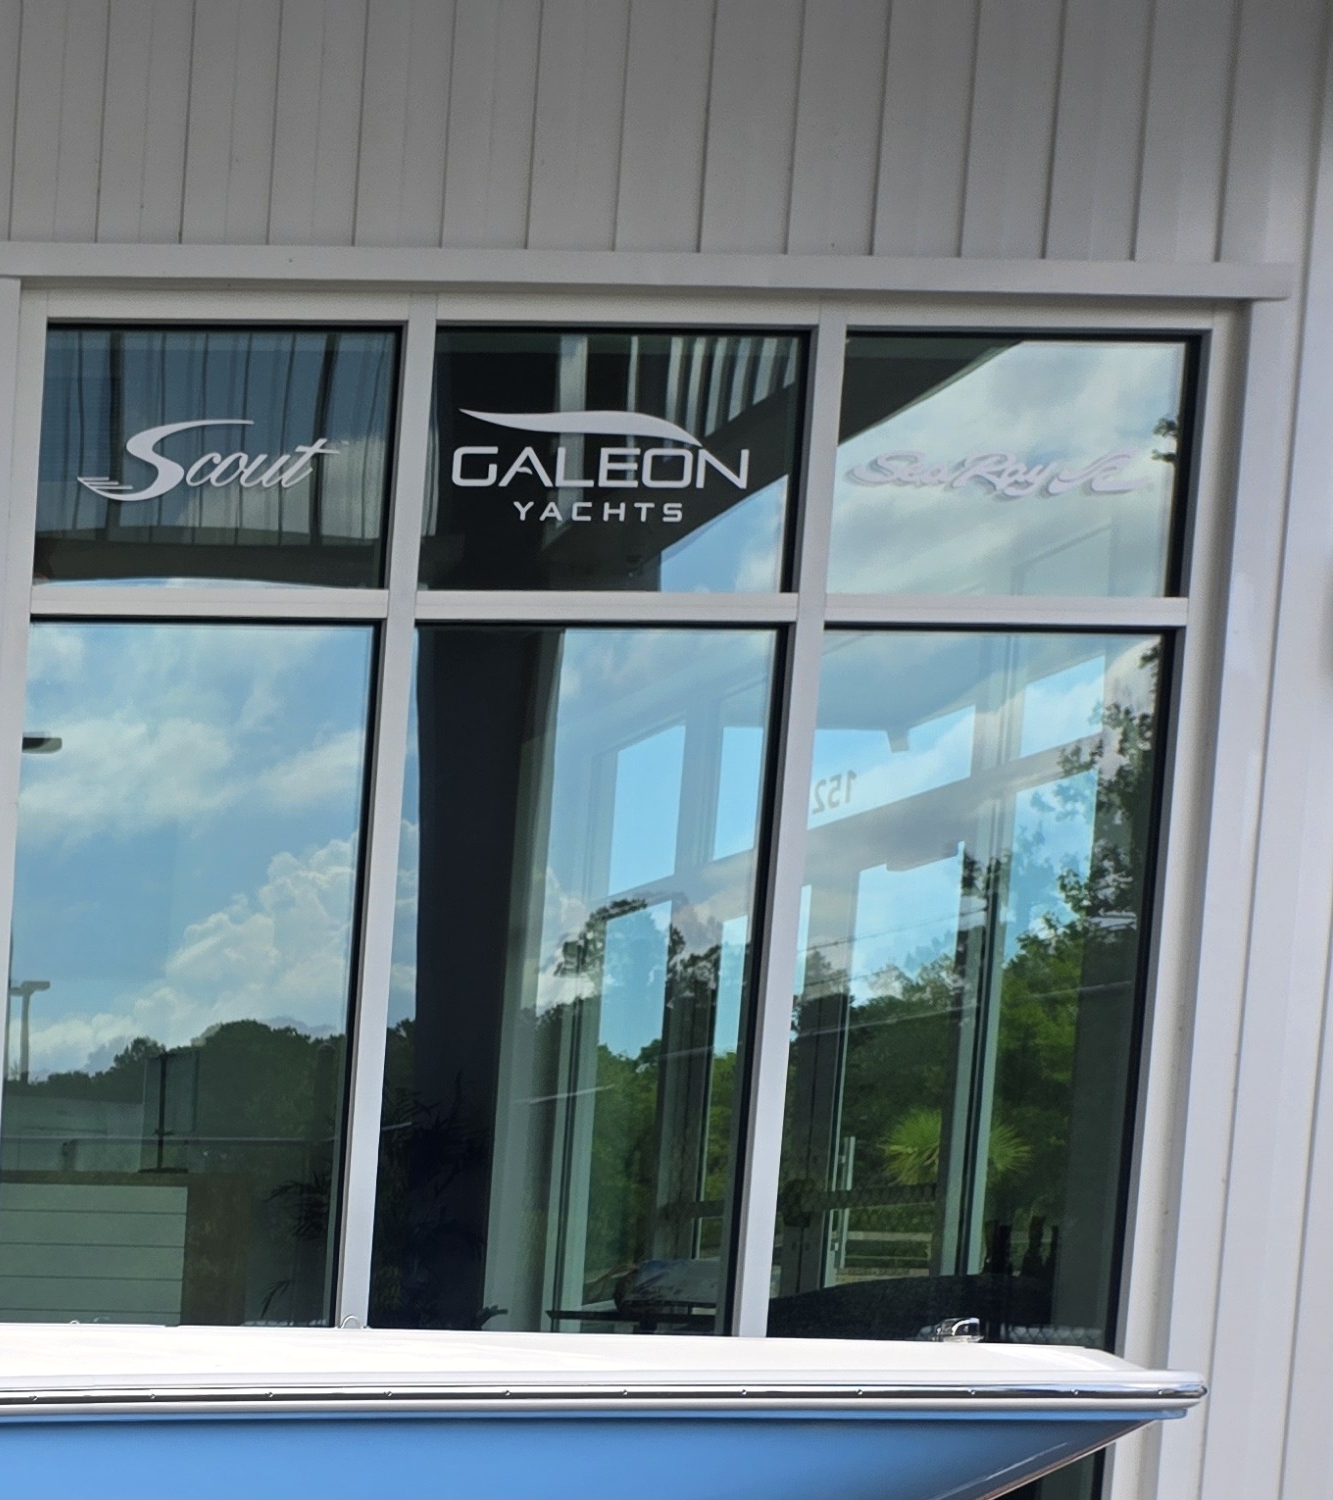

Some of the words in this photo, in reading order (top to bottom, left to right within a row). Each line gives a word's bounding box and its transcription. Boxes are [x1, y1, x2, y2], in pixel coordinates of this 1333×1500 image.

[77, 419, 341, 501] Scout
[451, 446, 750, 489] GALEON
[950, 452, 1059, 497] Ray
[513, 501, 683, 523] YACHTS
